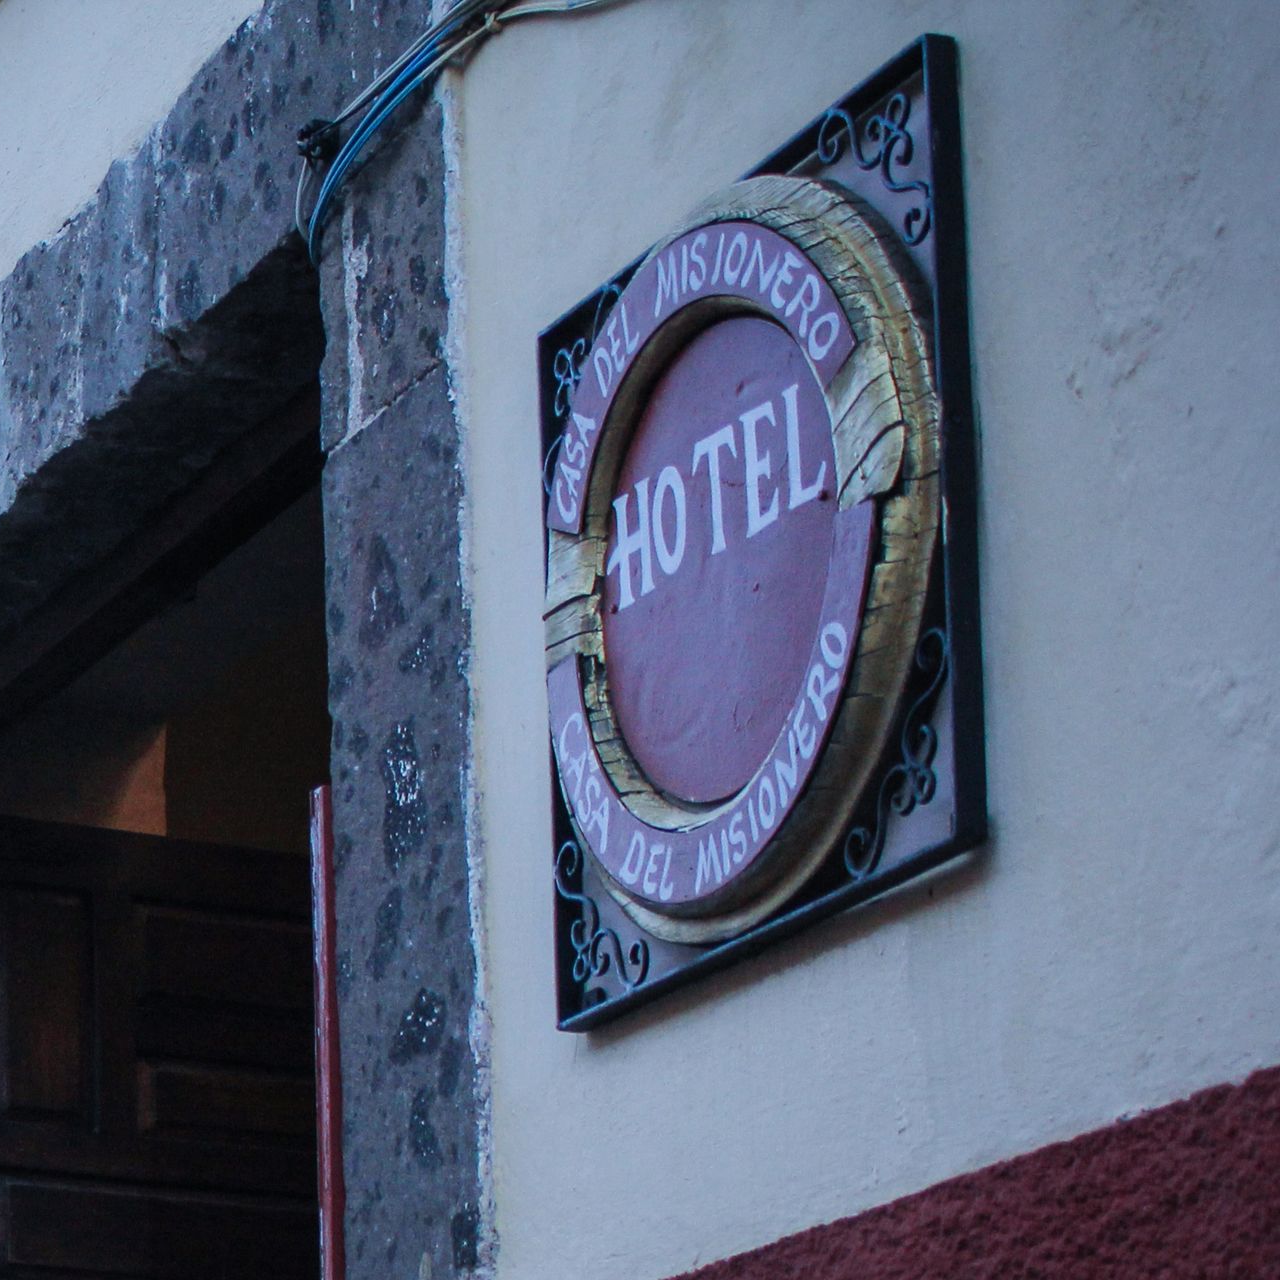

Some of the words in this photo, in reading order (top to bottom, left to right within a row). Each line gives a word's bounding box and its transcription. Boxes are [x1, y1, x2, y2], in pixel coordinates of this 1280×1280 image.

[554, 411, 596, 524] CASA
[593, 302, 640, 398] DEL
[654, 230, 840, 362] MISIONERO
[606, 383, 827, 611] HOTEL
[558, 712, 610, 854] CASA
[618, 830, 674, 901] DEL
[695, 621, 848, 896] MISIONERO
